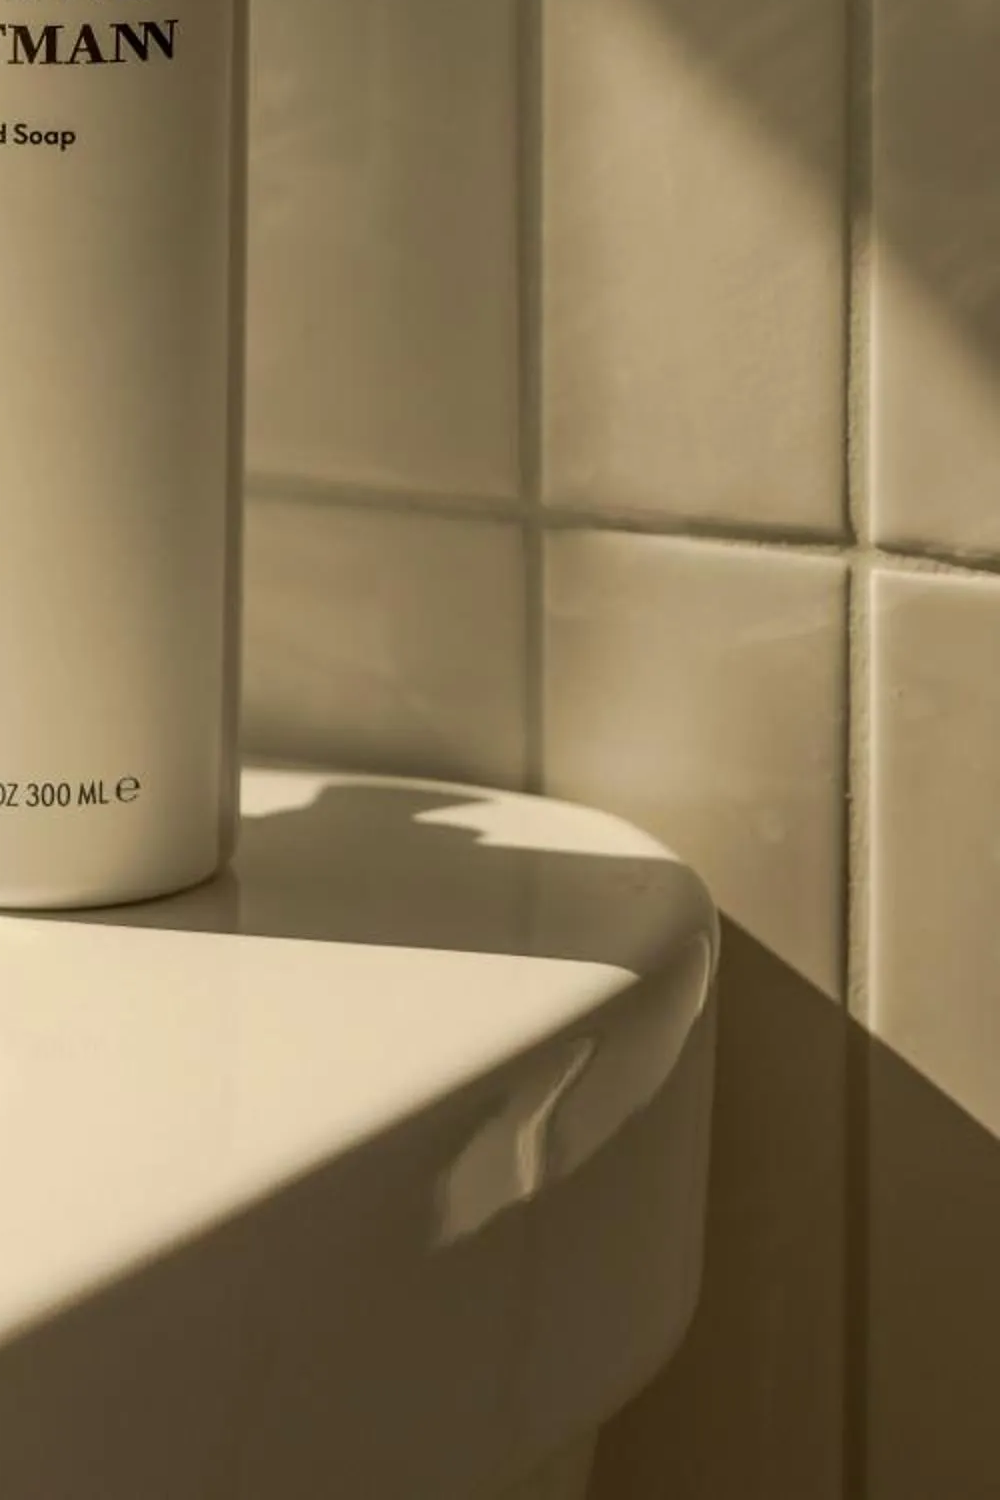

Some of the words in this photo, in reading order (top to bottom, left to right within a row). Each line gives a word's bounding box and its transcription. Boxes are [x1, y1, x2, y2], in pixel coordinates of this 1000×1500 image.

[13, 122, 77, 153] Soap
[24, 781, 72, 808] 300
[77, 779, 110, 806] ML
